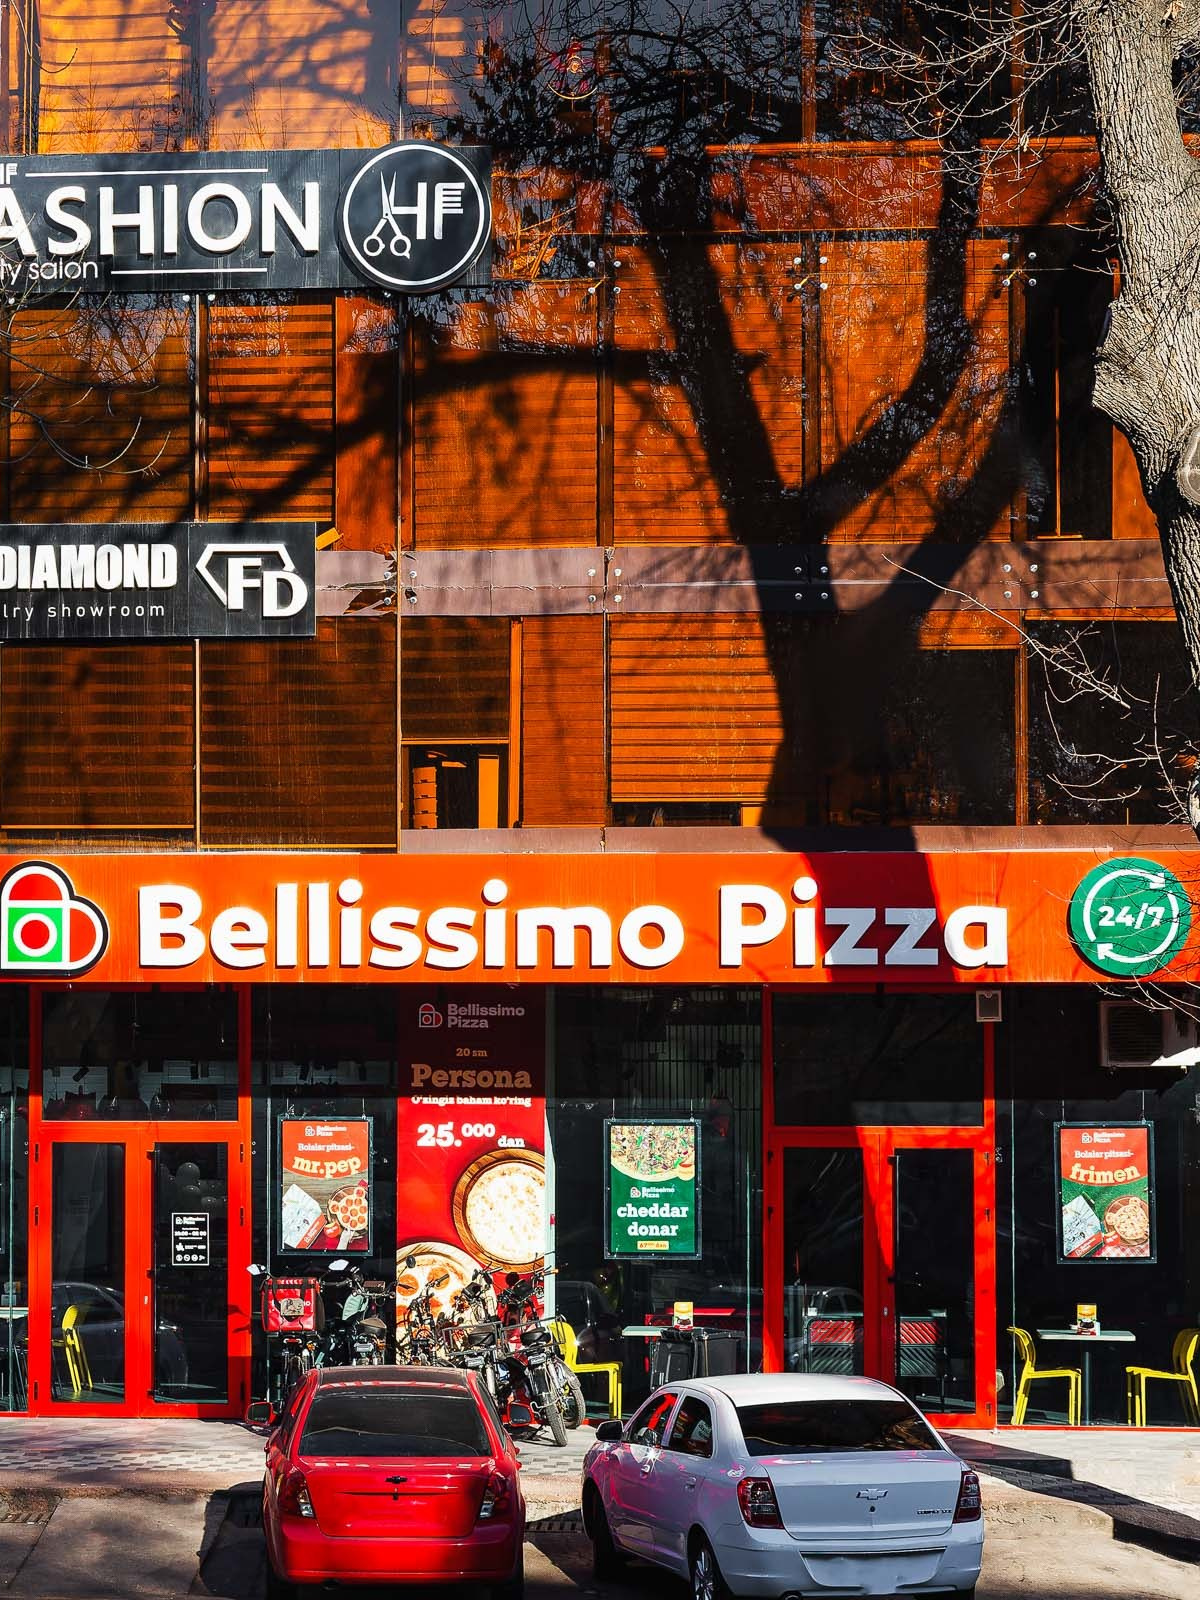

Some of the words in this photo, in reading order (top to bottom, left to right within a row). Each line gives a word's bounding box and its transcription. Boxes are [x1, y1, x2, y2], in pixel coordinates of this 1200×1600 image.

[29, 259, 98, 280] salon
[47, 603, 166, 618] showroom
[137, 879, 687, 970] Bellissimo
[718, 877, 1011, 969] Pizza
[1098, 903, 1166, 929] 24/7
[447, 1003, 526, 1016] Bellissimo
[447, 1016, 489, 1028] Pizza
[456, 1048, 471, 1057] 20
[472, 1049, 488, 1057] sm
[411, 1063, 533, 1089] Persona
[497, 1135, 526, 1148] dan
[293, 1156, 362, 1179] mr.pep
[1069, 1163, 1141, 1184] frimen
[616, 1203, 689, 1218] cheddar
[627, 1222, 679, 1236] donar
